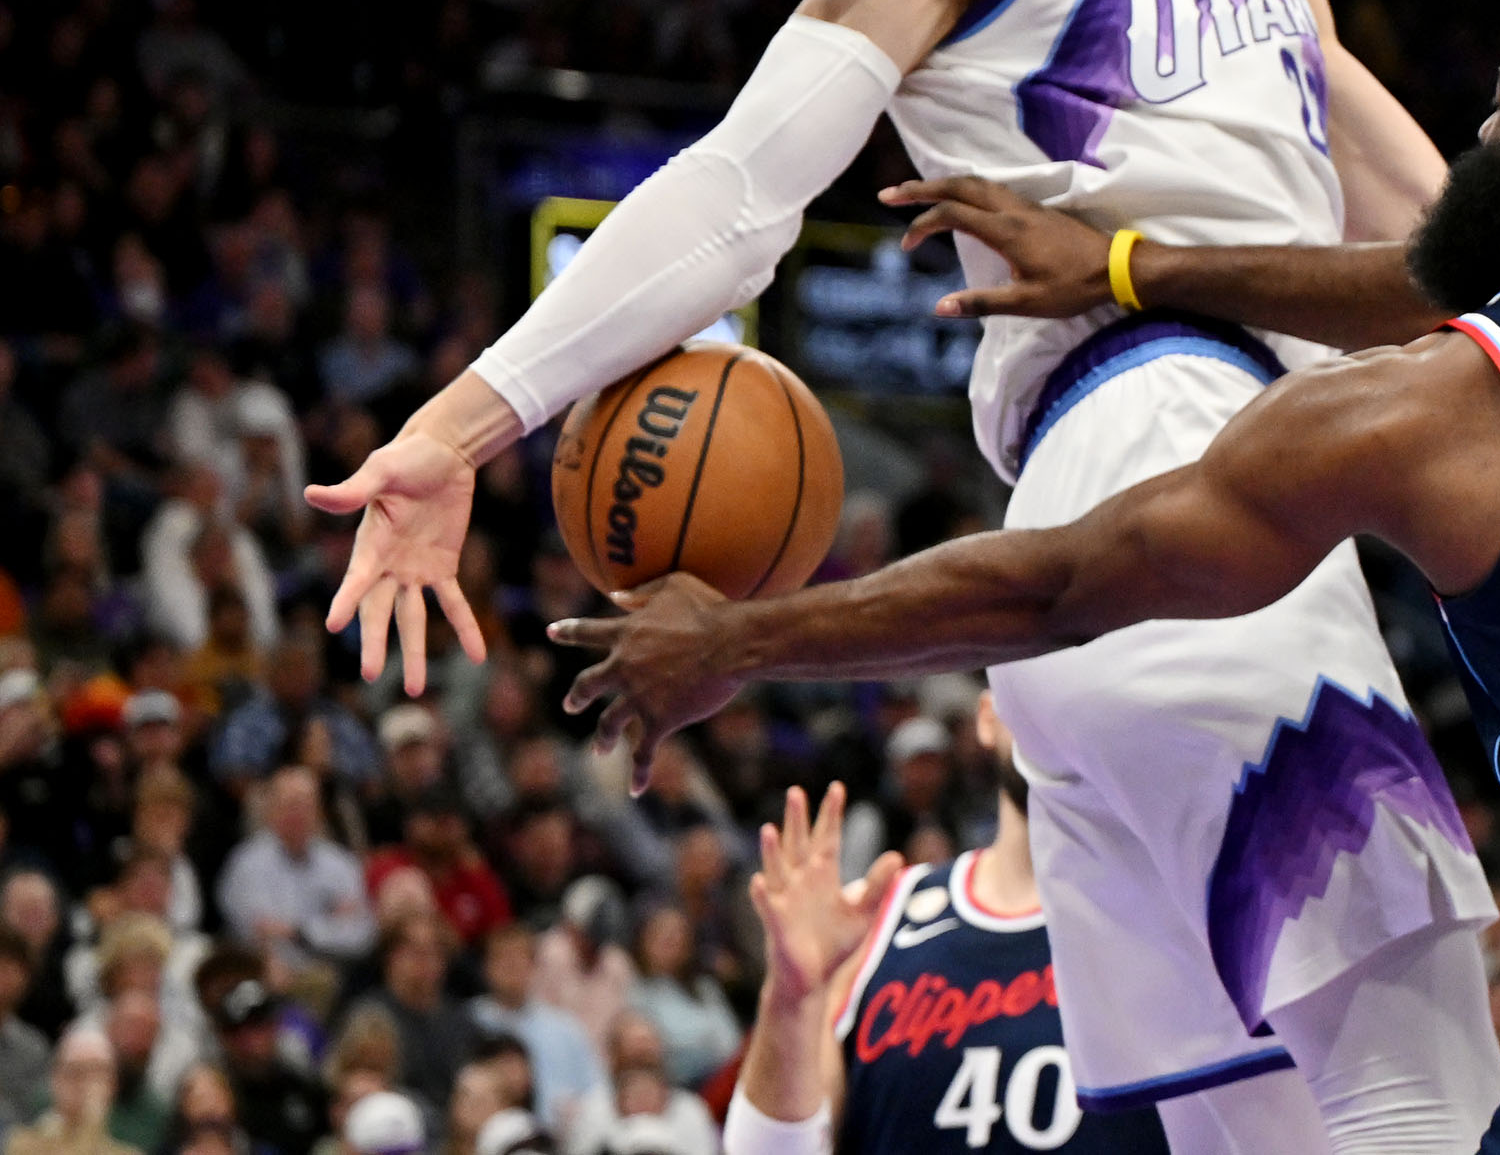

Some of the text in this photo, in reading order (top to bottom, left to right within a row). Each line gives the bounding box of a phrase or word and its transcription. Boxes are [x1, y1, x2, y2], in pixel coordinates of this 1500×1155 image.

[606, 384, 699, 566] Wilson
[856, 963, 1059, 1064] Clippe
[933, 1045, 1083, 1150] 40
